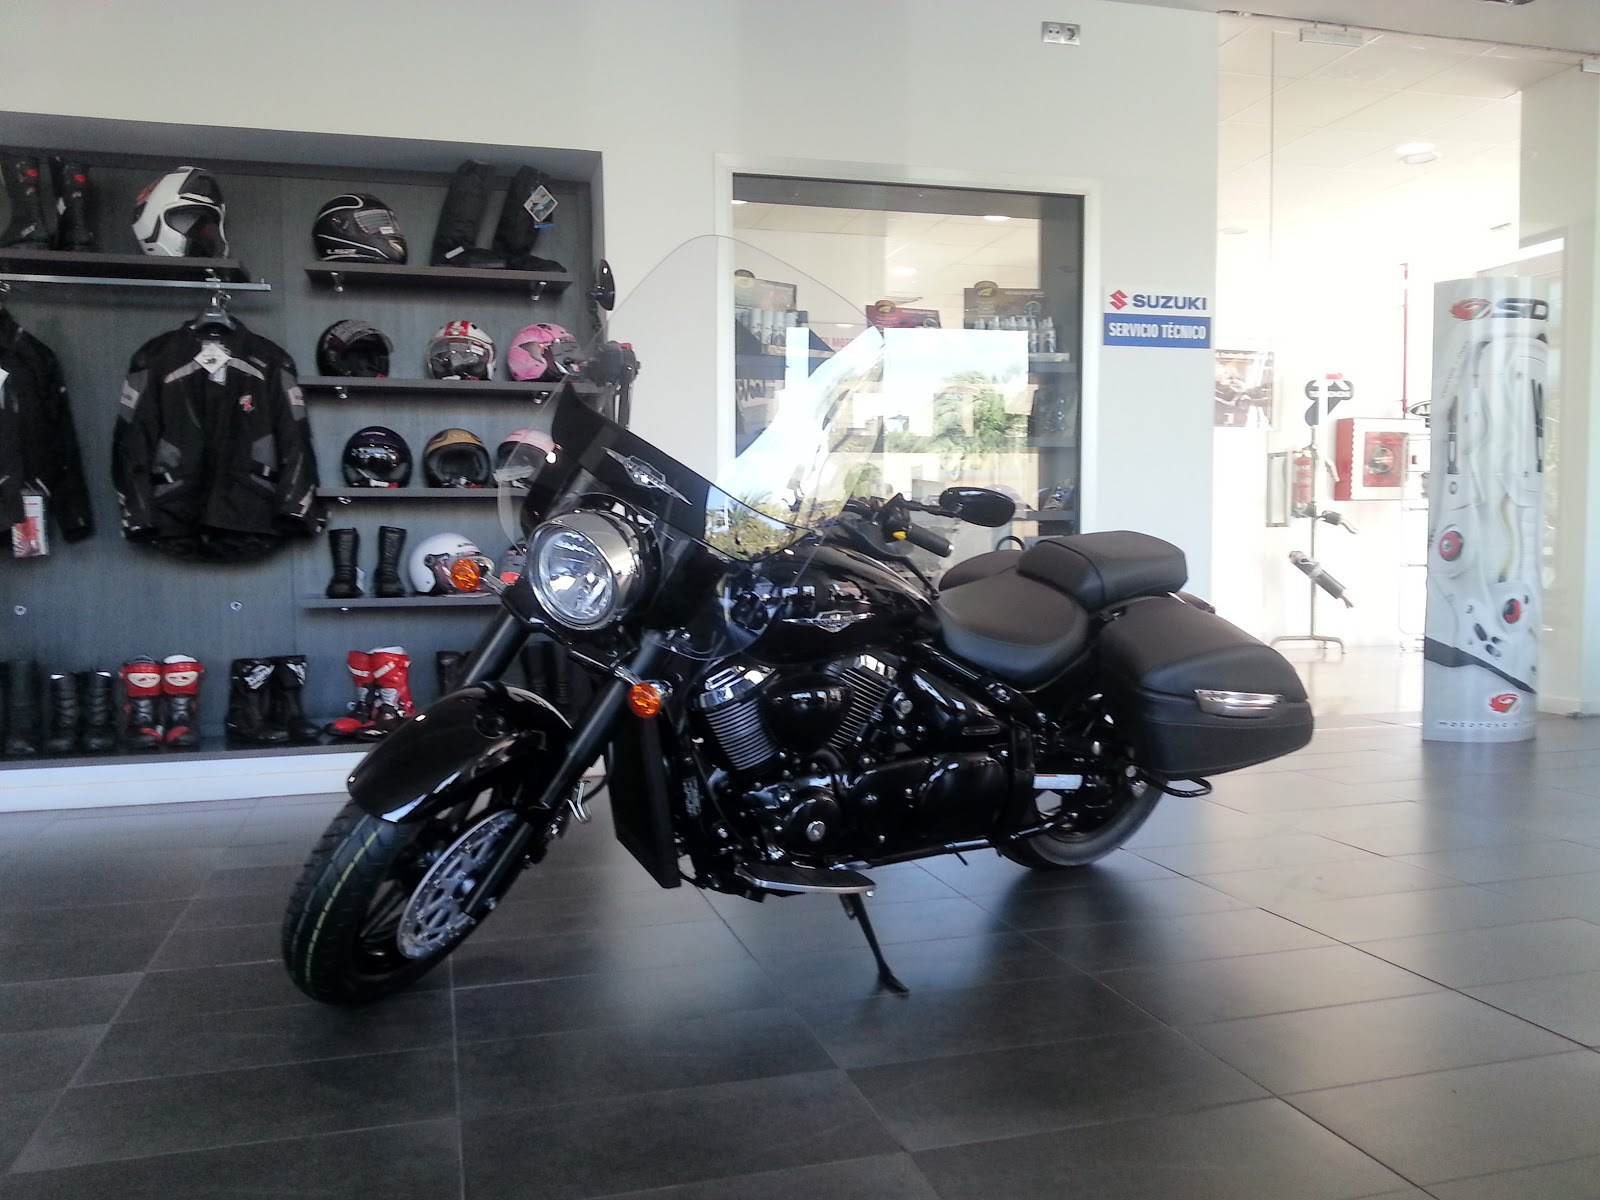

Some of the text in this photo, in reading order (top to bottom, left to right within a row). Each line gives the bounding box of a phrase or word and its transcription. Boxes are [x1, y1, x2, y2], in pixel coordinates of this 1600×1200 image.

[1132, 293, 1207, 311] SUZUKI
[1108, 321, 1207, 340] SERVICIO TÉCNICO
